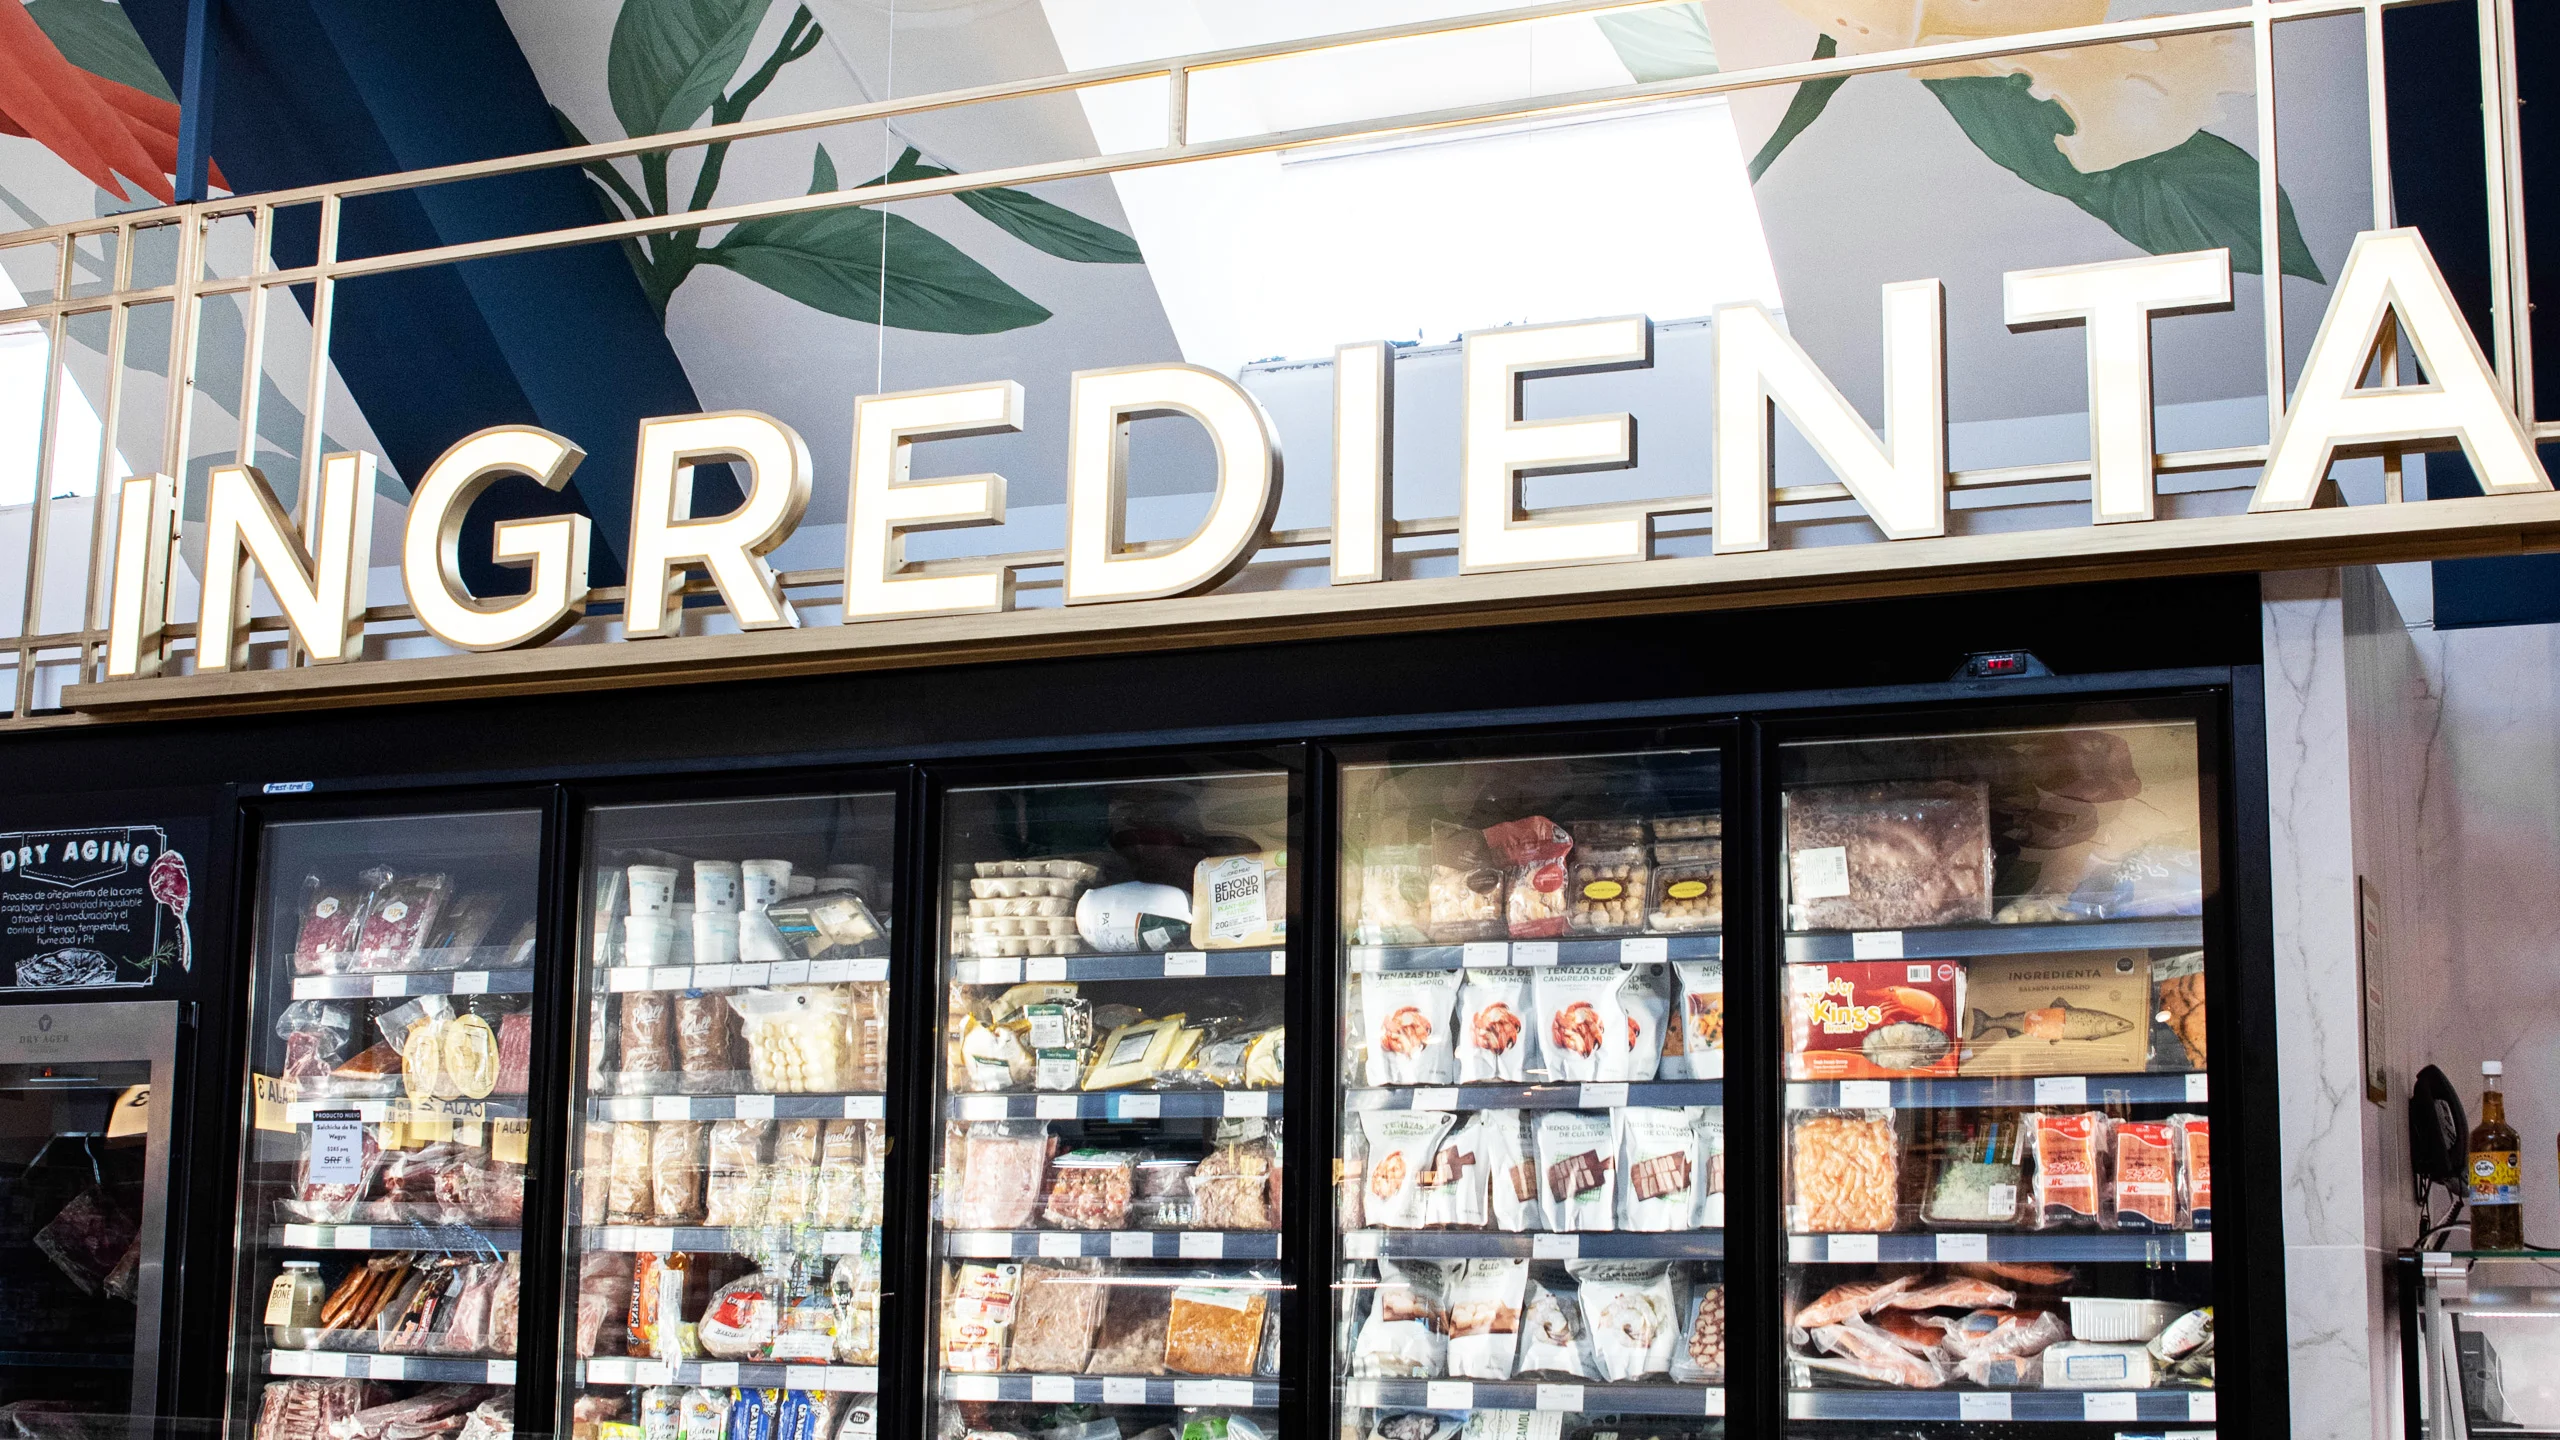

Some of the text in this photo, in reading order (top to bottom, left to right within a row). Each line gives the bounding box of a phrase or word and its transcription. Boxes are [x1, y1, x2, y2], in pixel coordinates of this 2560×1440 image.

[106, 226, 2552, 680] INGREDIENTA
[1, 840, 149, 872] DRY AGING
[1214, 875, 1259, 893] BEYOND
[34, 891, 45, 899] de
[97, 887, 108, 897] de
[110, 887, 118, 896] la
[1215, 885, 1259, 903] BURGER
[1, 905, 20, 913] para
[61, 900, 98, 909] suavidad
[43, 914, 54, 922] de
[55, 913, 64, 921] la
[120, 909, 128, 919] el
[37, 935, 75, 945] humedad
[83, 934, 94, 943] PH
[1378, 971, 1441, 981] TENAZAS DE
[1517, 968, 1532, 977] DE
[1546, 967, 1615, 975] TENAZAS DE
[2008, 969, 2102, 981] INGREDIENTA
[2051, 984, 2091, 992] AHUMADO
[1813, 1000, 1882, 1031] Kings
[1824, 1023, 1854, 1034] Brand
[19, 1034, 69, 1044] DRY AGER
[2124, 1185, 2139, 1193] JFC
[272, 1290, 291, 1300] BONE
